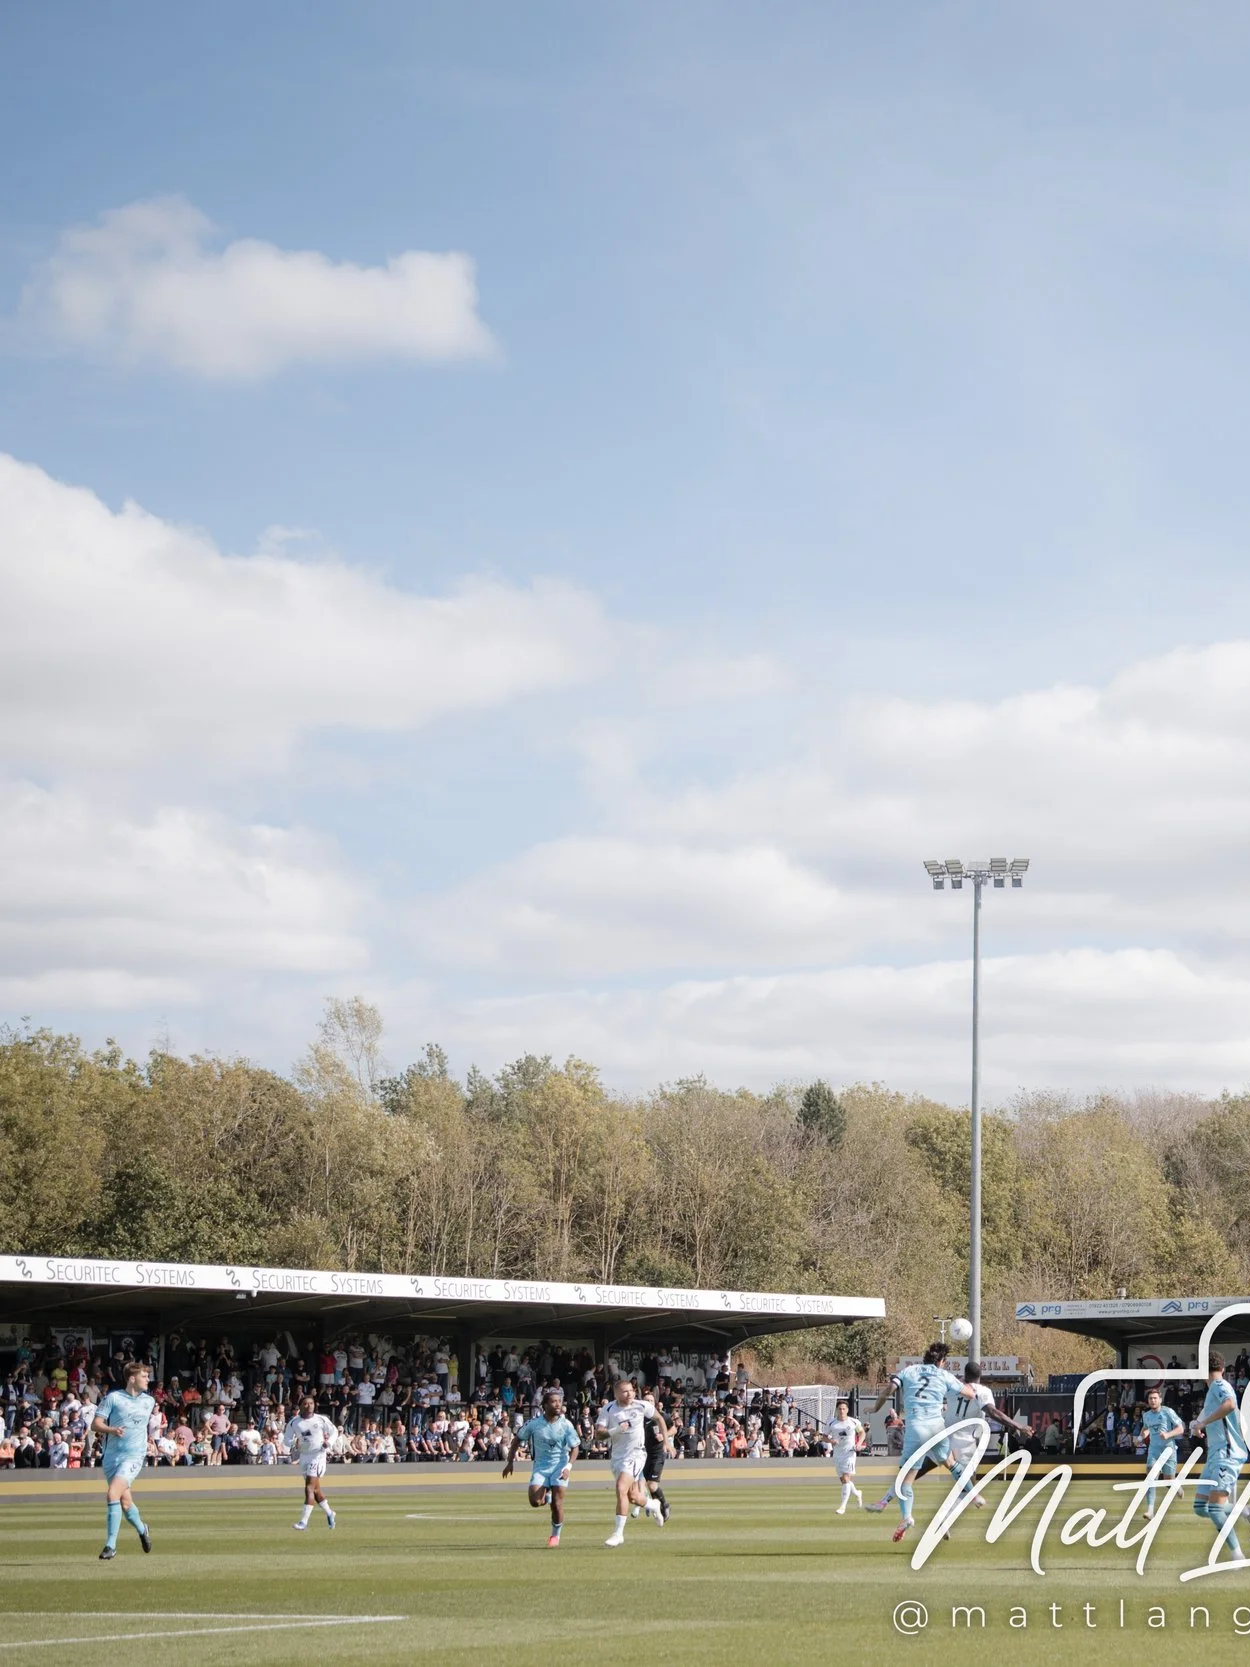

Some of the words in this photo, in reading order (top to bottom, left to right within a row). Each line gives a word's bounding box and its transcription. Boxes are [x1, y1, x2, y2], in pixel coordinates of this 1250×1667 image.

[46, 1259, 121, 1283] SECURITEC
[135, 1264, 195, 1286] SYSTEMS
[252, 1269, 317, 1292] SECURITEC
[331, 1274, 383, 1295] SYSTEMS
[434, 1278, 492, 1299] SECURITEC
[503, 1282, 550, 1301] SYSTEMS
[596, 1286, 647, 1306] SECURITEC
[657, 1289, 699, 1308] SYSTEMS
[1041, 1304, 1061, 1315] prg
[1188, 1299, 1208, 1310] prg
[914, 1375, 930, 1400] 2
